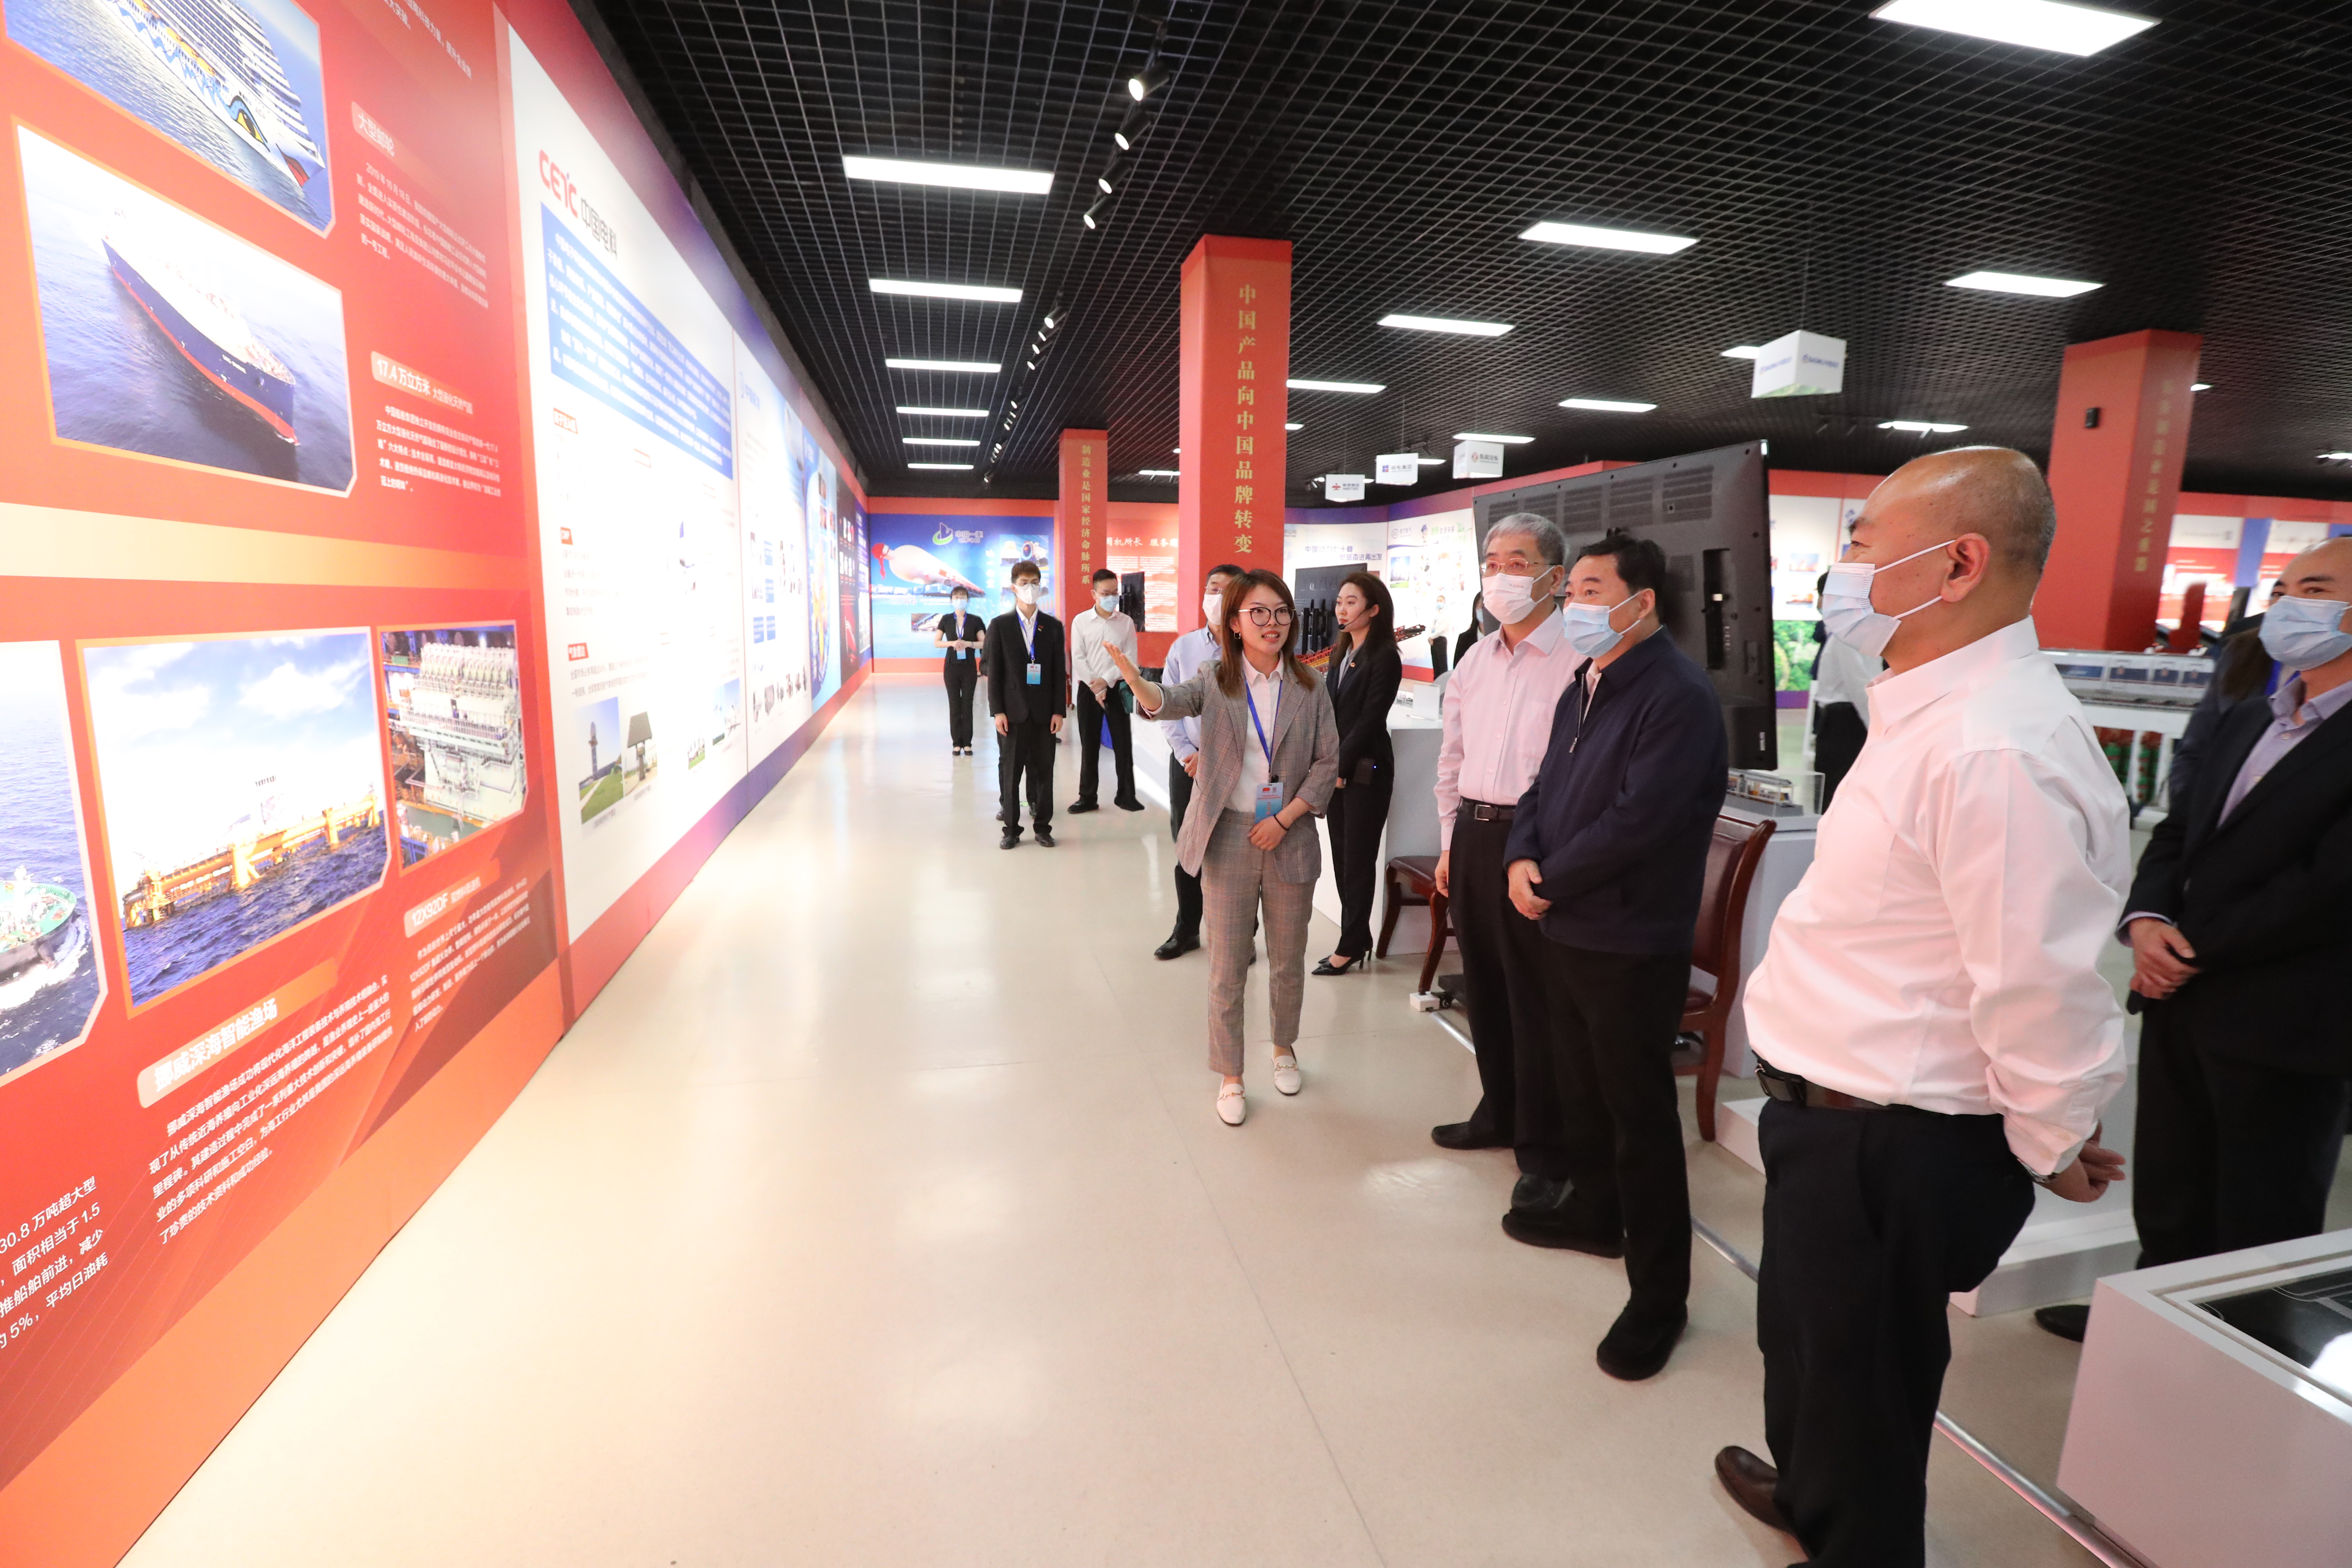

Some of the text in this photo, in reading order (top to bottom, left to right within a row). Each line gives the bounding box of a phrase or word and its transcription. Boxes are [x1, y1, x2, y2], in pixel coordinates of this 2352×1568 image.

[581, 197, 618, 260] 中国电科
[1234, 284, 1257, 554] 中国产品向中国品牌转变
[1081, 444, 1092, 585] 制造业是国家经济命脉所系
[154, 998, 278, 1092] 挪威深海智能渔场
[159, 1147, 273, 1245] 了珍贵的技术资料和成功经验。
